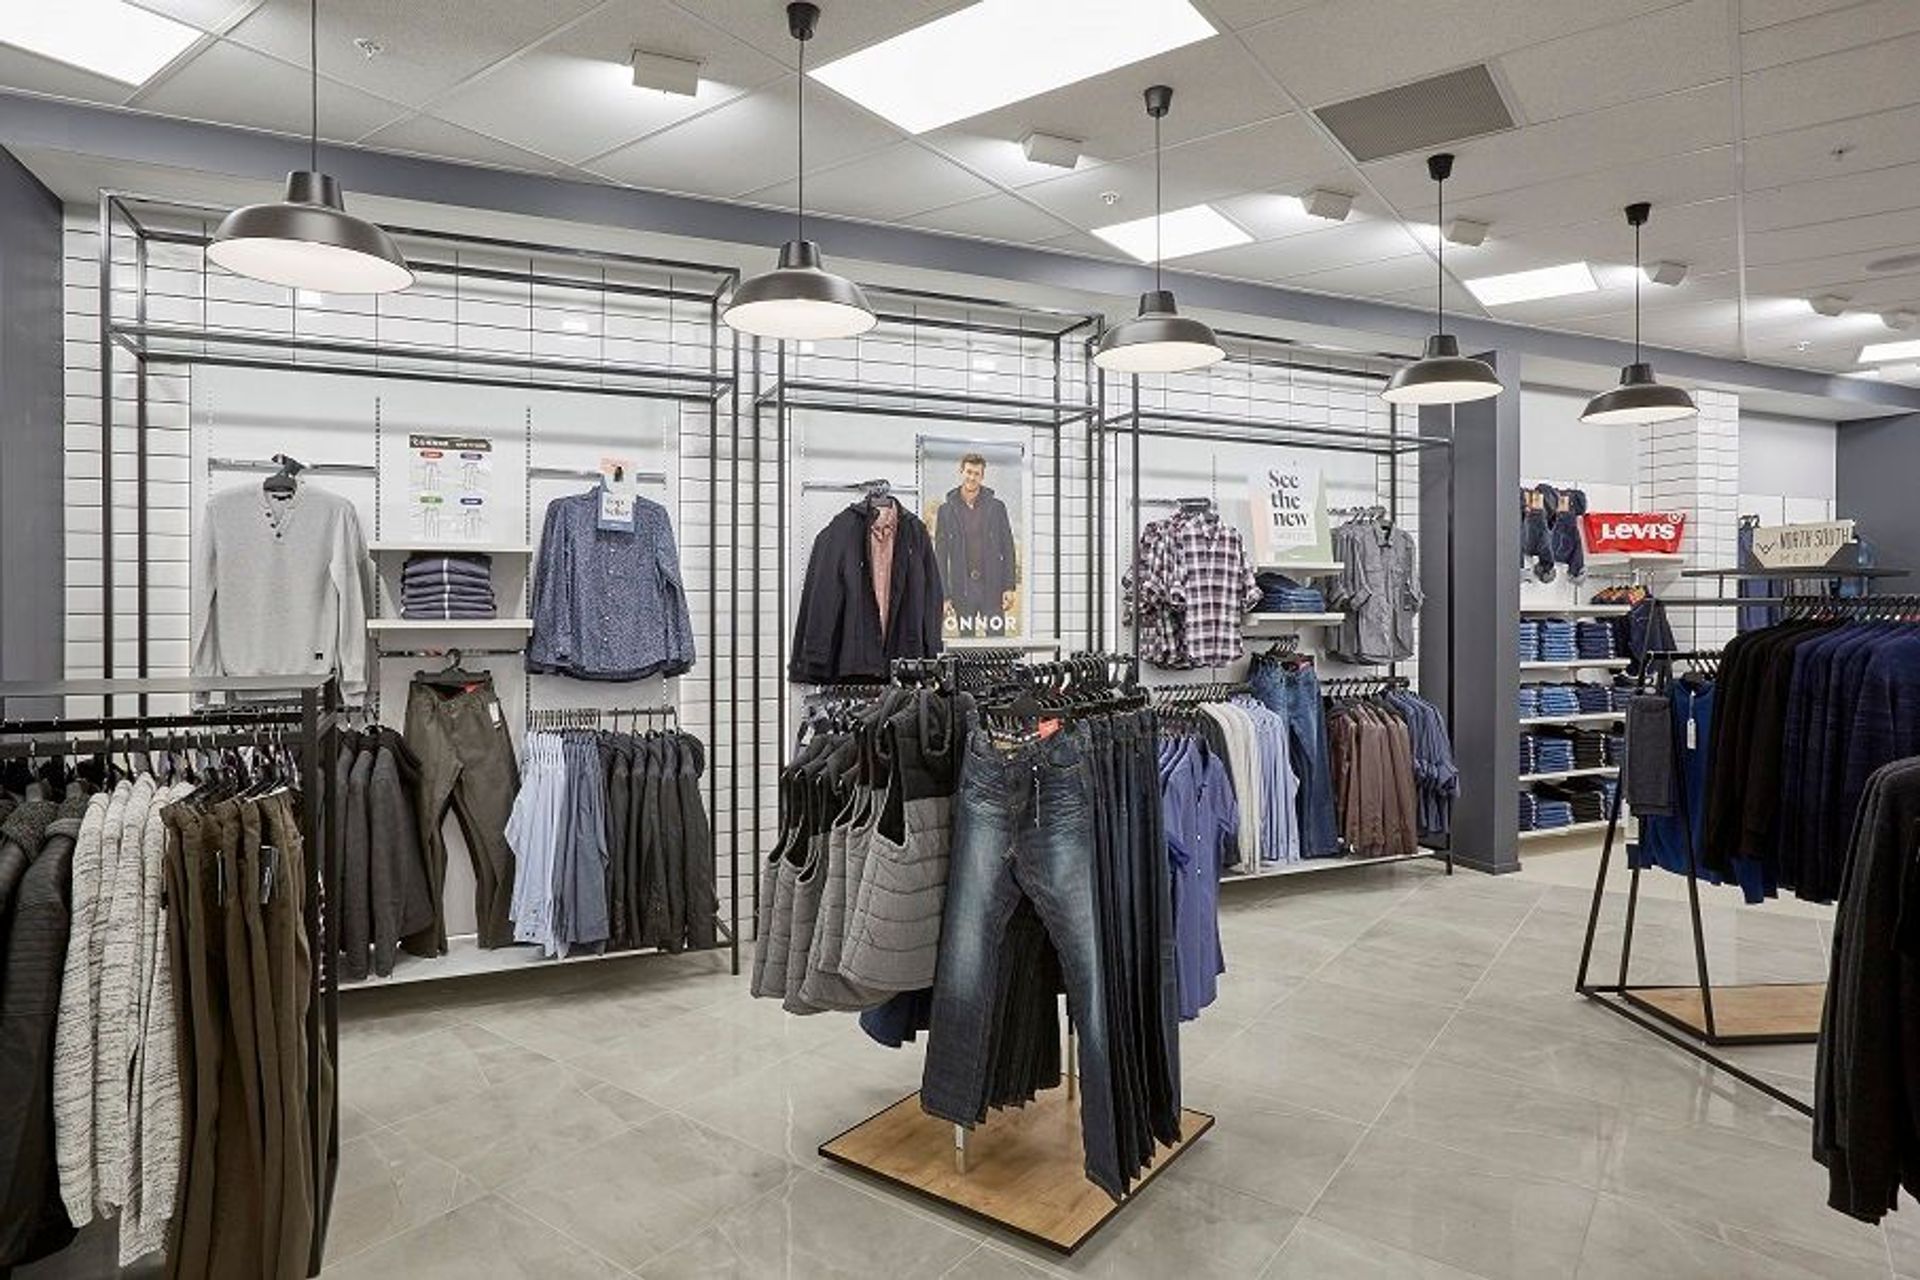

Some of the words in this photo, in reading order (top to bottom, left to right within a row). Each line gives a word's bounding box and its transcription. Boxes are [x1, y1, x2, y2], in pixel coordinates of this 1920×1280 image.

[1268, 470, 1298, 488] See
[1271, 489, 1300, 509] the
[1273, 513, 1307, 526] new
[1780, 531, 1811, 549] NORTH
[1815, 527, 1849, 547] SOUTH
[944, 616, 1016, 631] ONNOR
